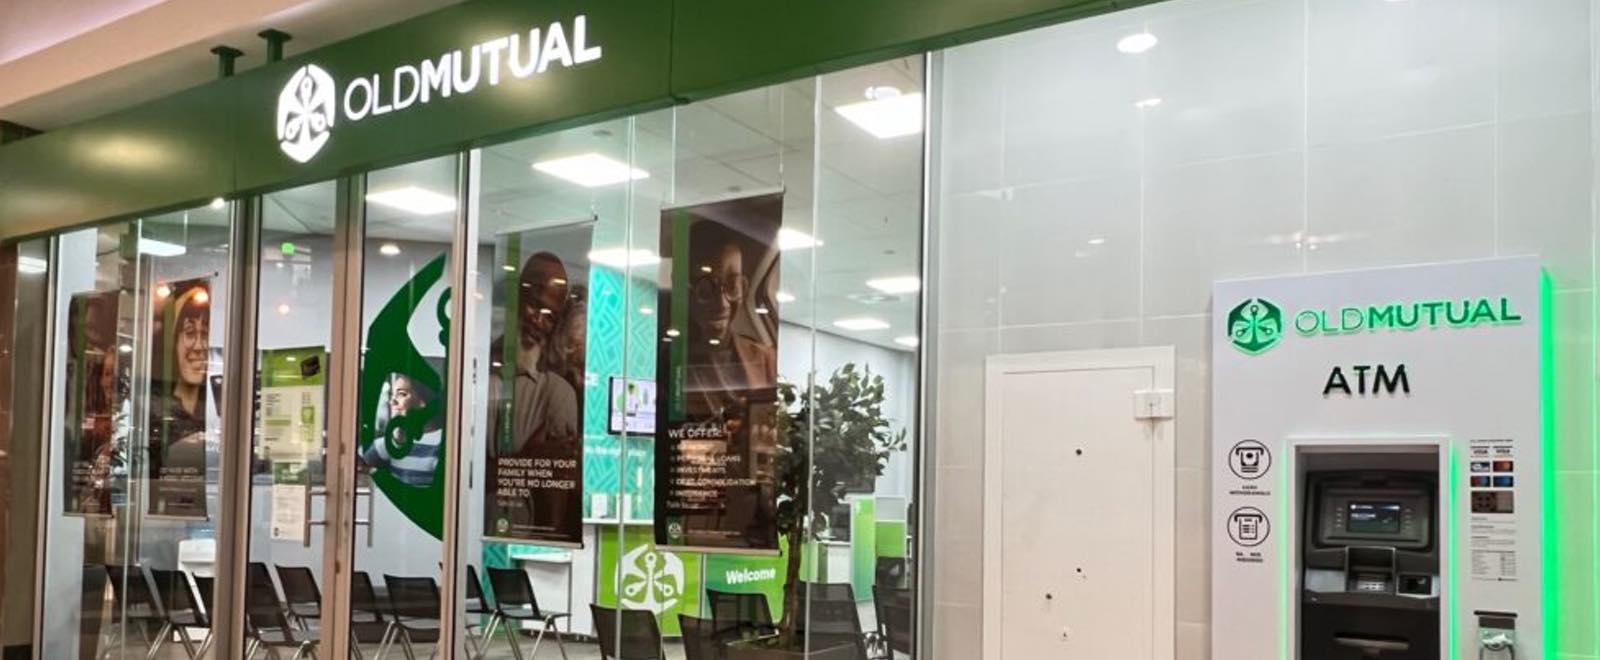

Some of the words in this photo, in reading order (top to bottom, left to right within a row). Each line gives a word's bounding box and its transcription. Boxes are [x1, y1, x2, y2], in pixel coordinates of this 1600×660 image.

[1322, 363, 1411, 396] ATM
[668, 429, 684, 438] WE
[498, 458, 533, 466] PROVIDE
[534, 459, 552, 467] FOR
[553, 460, 577, 468] YOUR
[498, 468, 525, 477] FAMILY
[527, 469, 553, 478] WHEN
[498, 478, 526, 487] YOU'RE
[527, 479, 540, 488] NO
[541, 480, 576, 489] LONGER
[497, 488, 516, 496] ABLE
[519, 489, 530, 497] TO
[725, 567, 777, 585] Welcome
